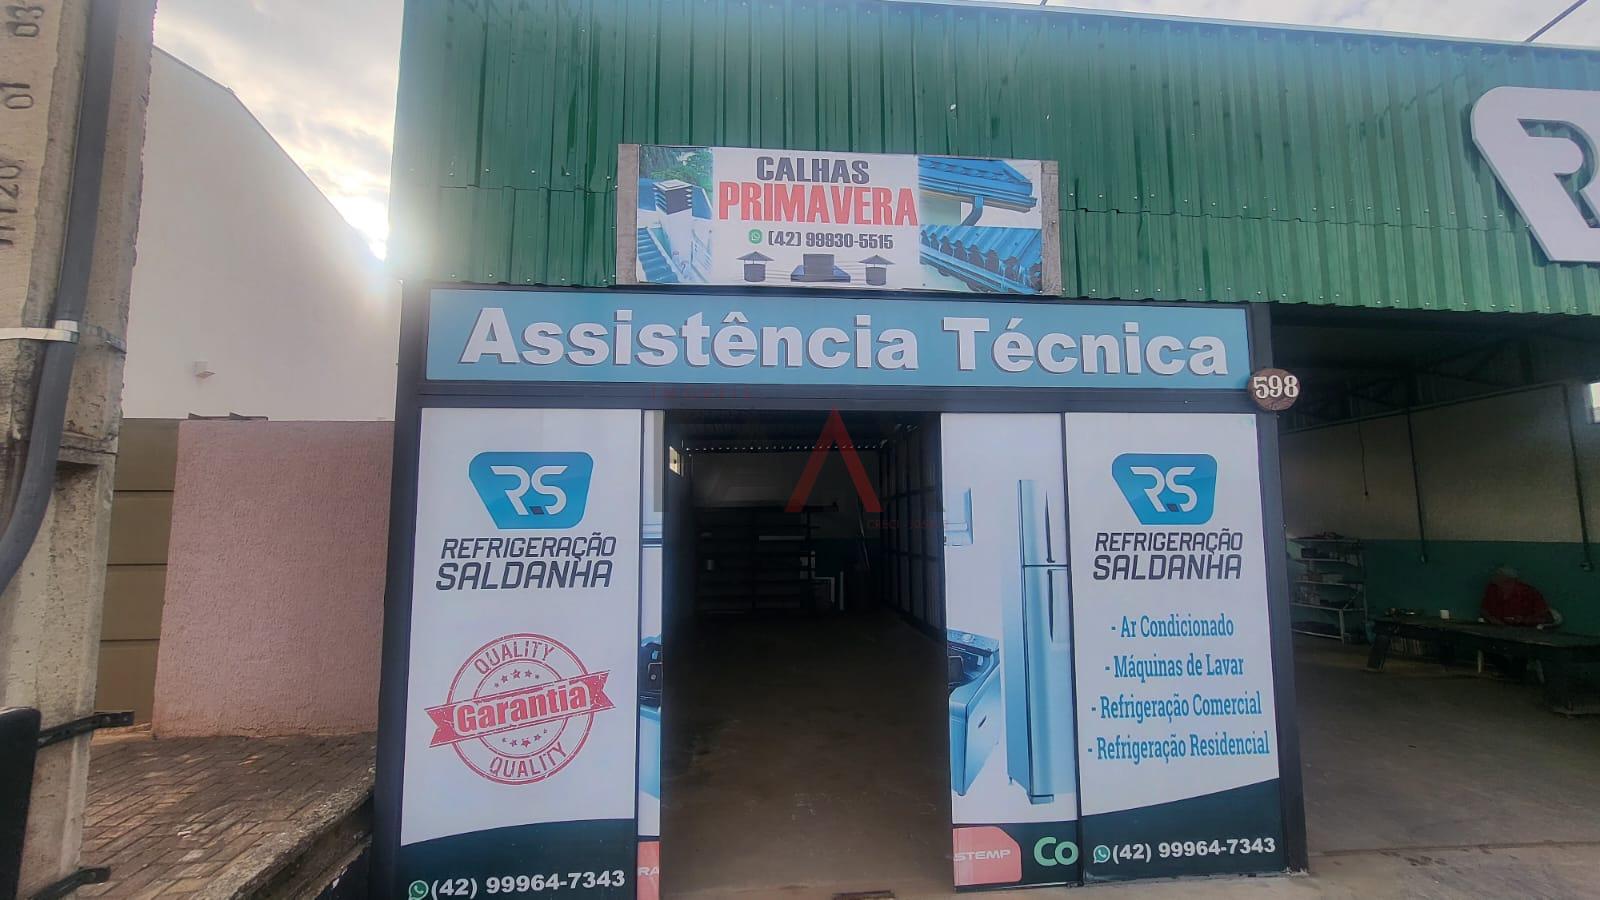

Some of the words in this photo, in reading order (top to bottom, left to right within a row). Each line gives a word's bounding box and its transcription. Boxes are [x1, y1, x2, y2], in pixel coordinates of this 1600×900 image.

[756, 156, 870, 184] CALHAS
[718, 181, 919, 226] PRIMAVERA
[768, 231, 802, 248] (42)
[458, 307, 919, 371] Assistência
[942, 316, 1229, 376] Técnica
[1252, 375, 1300, 399] 598
[490, 465, 568, 516] RS
[1129, 466, 1198, 513] RS
[441, 532, 617, 561] REFRIGERAÇÃO
[1095, 528, 1243, 555] REFRIGERAÇÃO
[435, 560, 613, 590] SALDANHA
[1093, 554, 1242, 581] SALDANHA
[1120, 615, 1137, 638] Ar
[1140, 613, 1235, 638] Condicionado
[474, 641, 555, 675] QUALITY
[1113, 653, 1183, 683] Máquinas
[1187, 653, 1202, 675] de
[1205, 653, 1244, 676] Lavar
[456, 683, 587, 733] Garantia
[1100, 693, 1189, 724] Refrigeração
[1193, 691, 1262, 717] Comercial
[489, 740, 568, 779] QUALITY
[1096, 734, 1186, 765] Refrigeração
[1189, 731, 1270, 757] Residencial
[1033, 836, 1079, 866] Co
[1112, 843, 1151, 865] (42)
[1158, 837, 1276, 859] 99964-7343
[431, 877, 478, 899] (42)
[486, 869, 625, 894] 99964-7343
